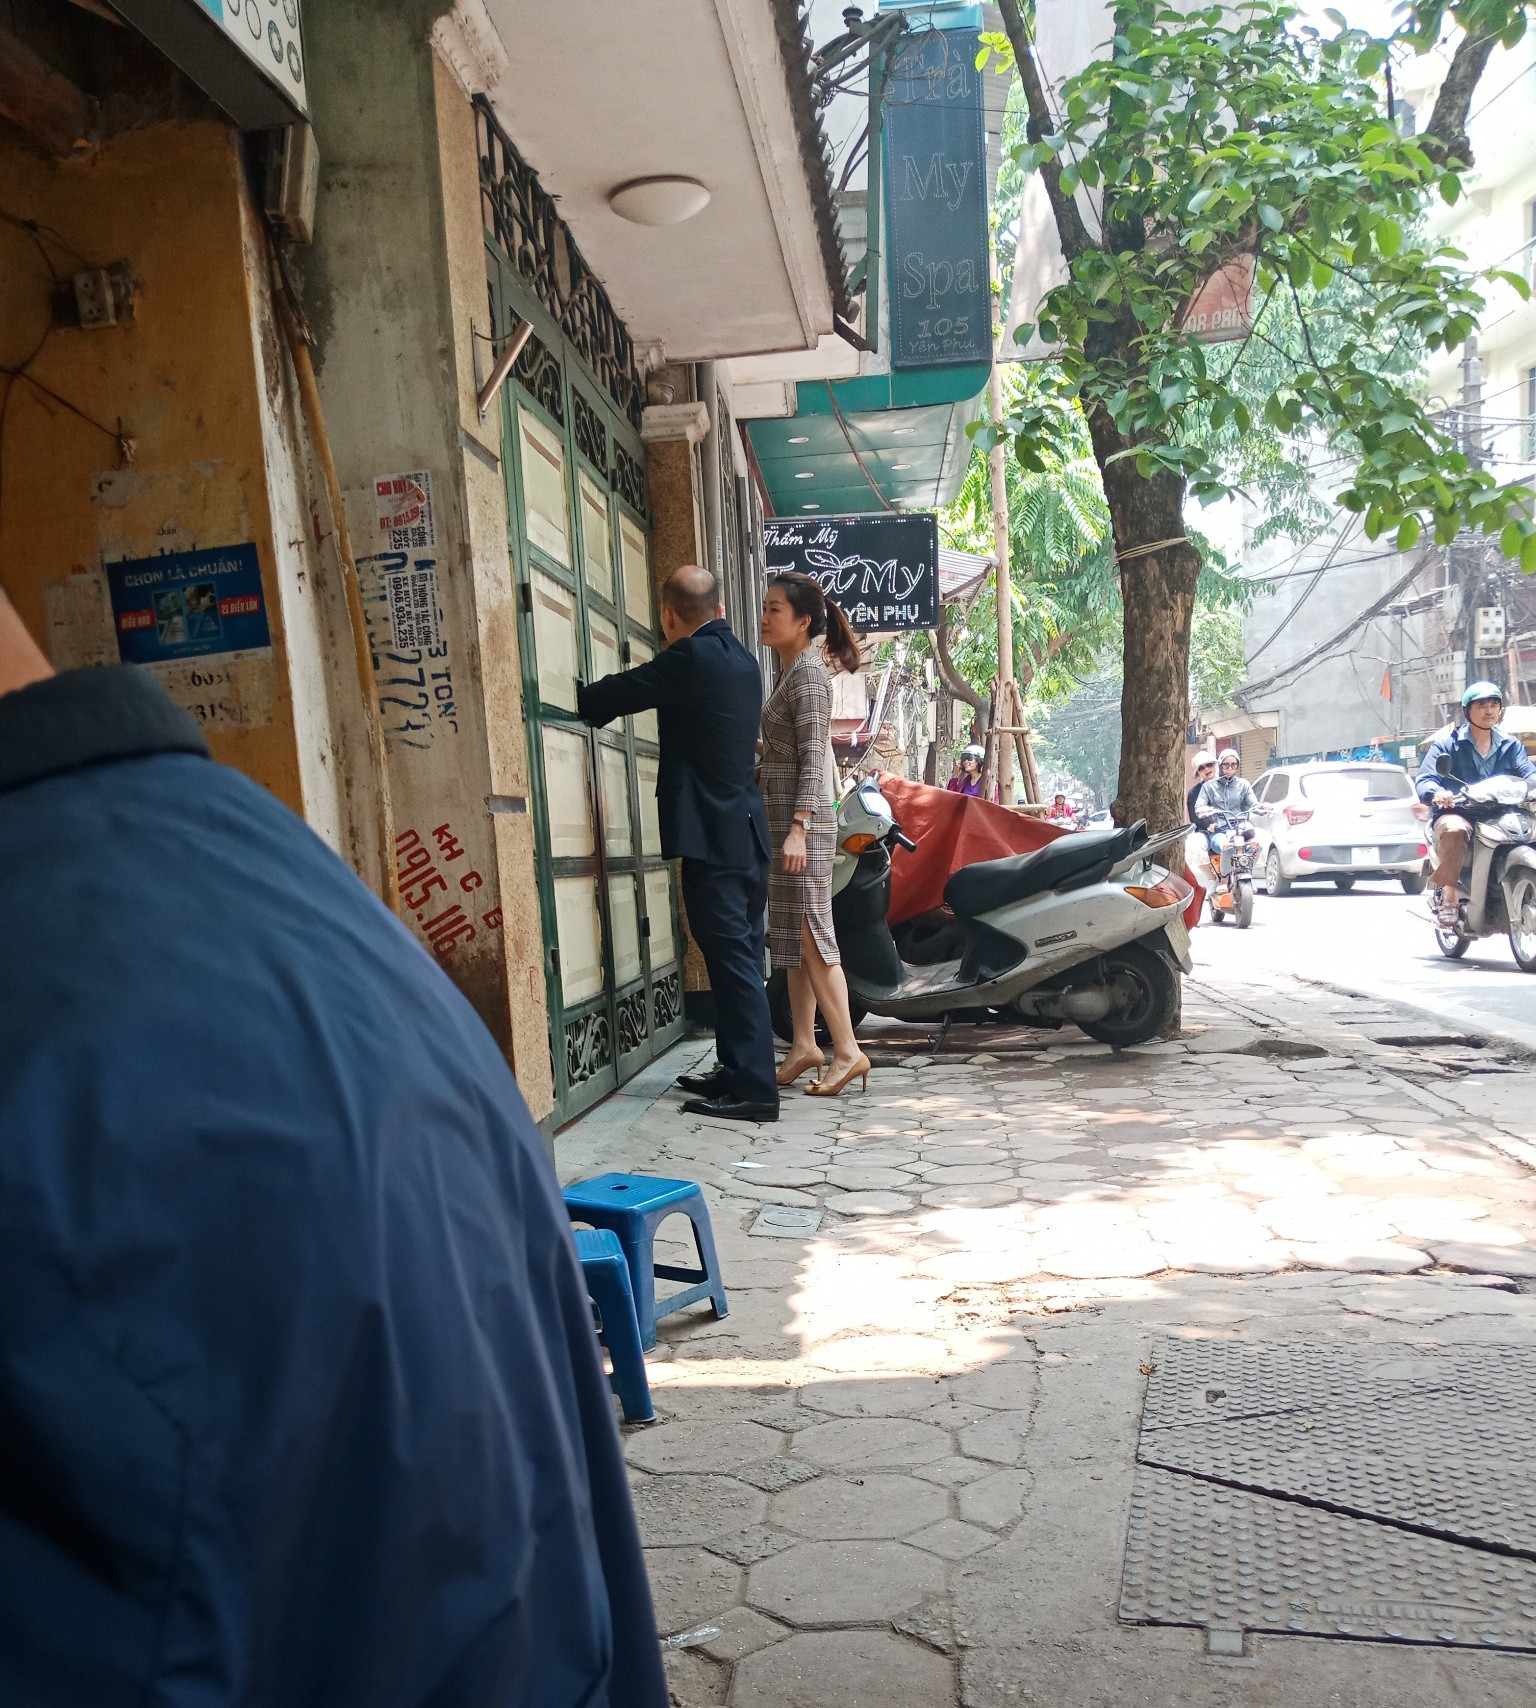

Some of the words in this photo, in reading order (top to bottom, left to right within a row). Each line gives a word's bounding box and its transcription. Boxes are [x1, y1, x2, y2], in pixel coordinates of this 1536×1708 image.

[900, 152, 974, 211] My
[903, 251, 979, 310] Spa
[917, 317, 970, 338] 105
[859, 558, 925, 600] My
[392, 576, 410, 649] 0946.934.235
[883, 604, 920, 624] PHỤ
